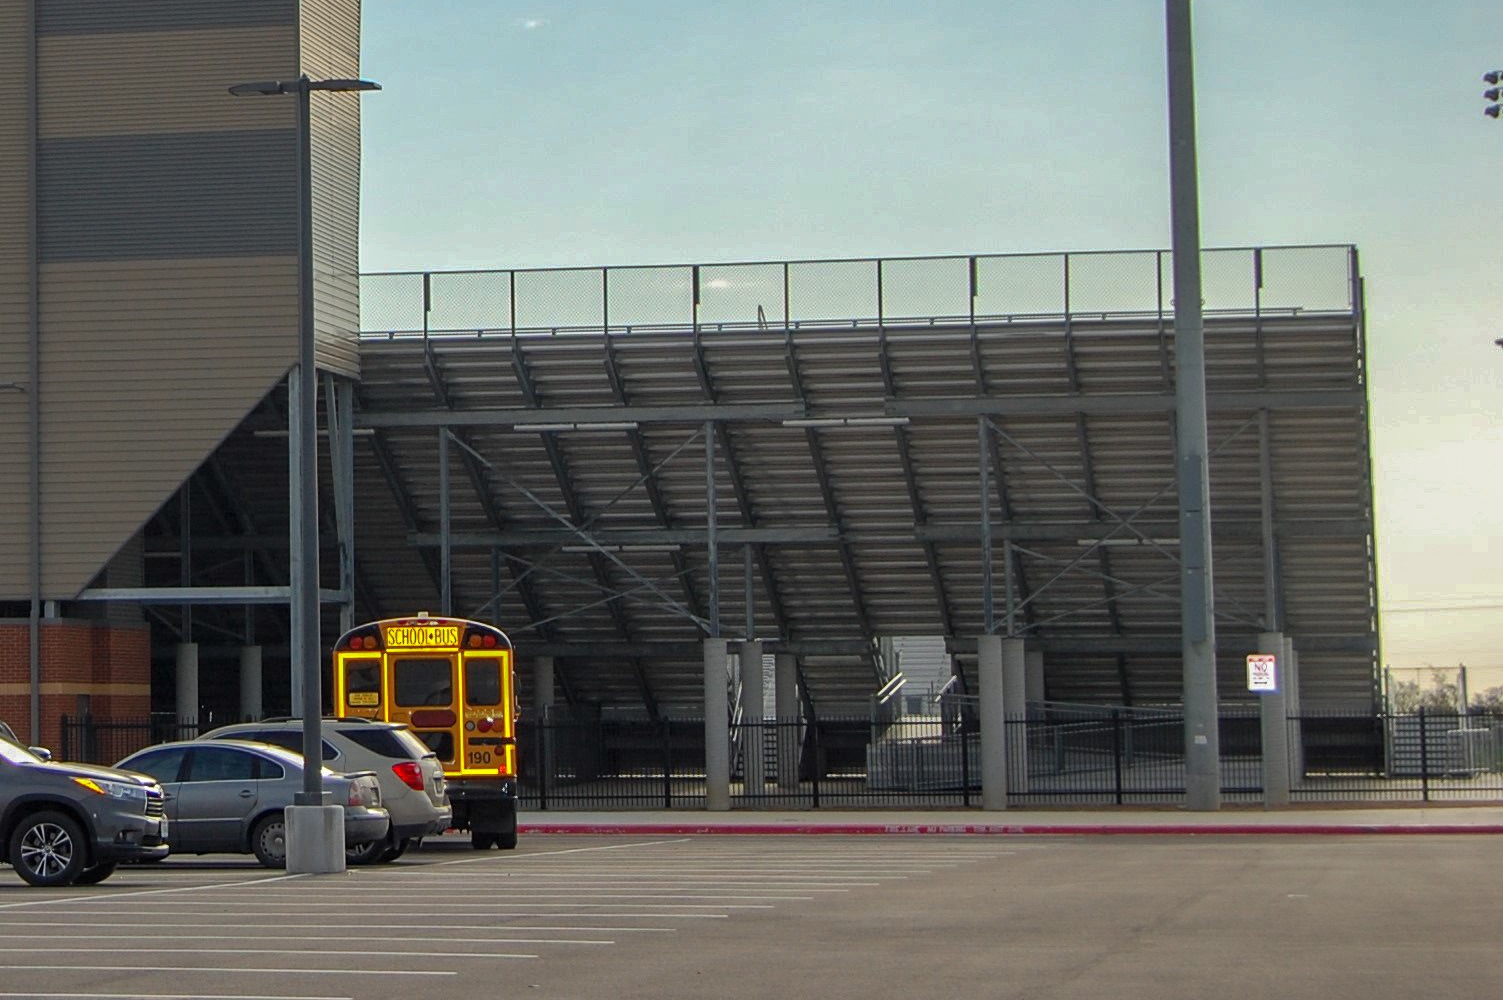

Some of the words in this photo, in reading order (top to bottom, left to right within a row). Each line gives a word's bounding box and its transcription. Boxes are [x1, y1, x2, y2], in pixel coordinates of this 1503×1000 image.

[388, 628, 431, 645] SCHOOL
[434, 628, 458, 645] BUS
[468, 751, 491, 764] 190
